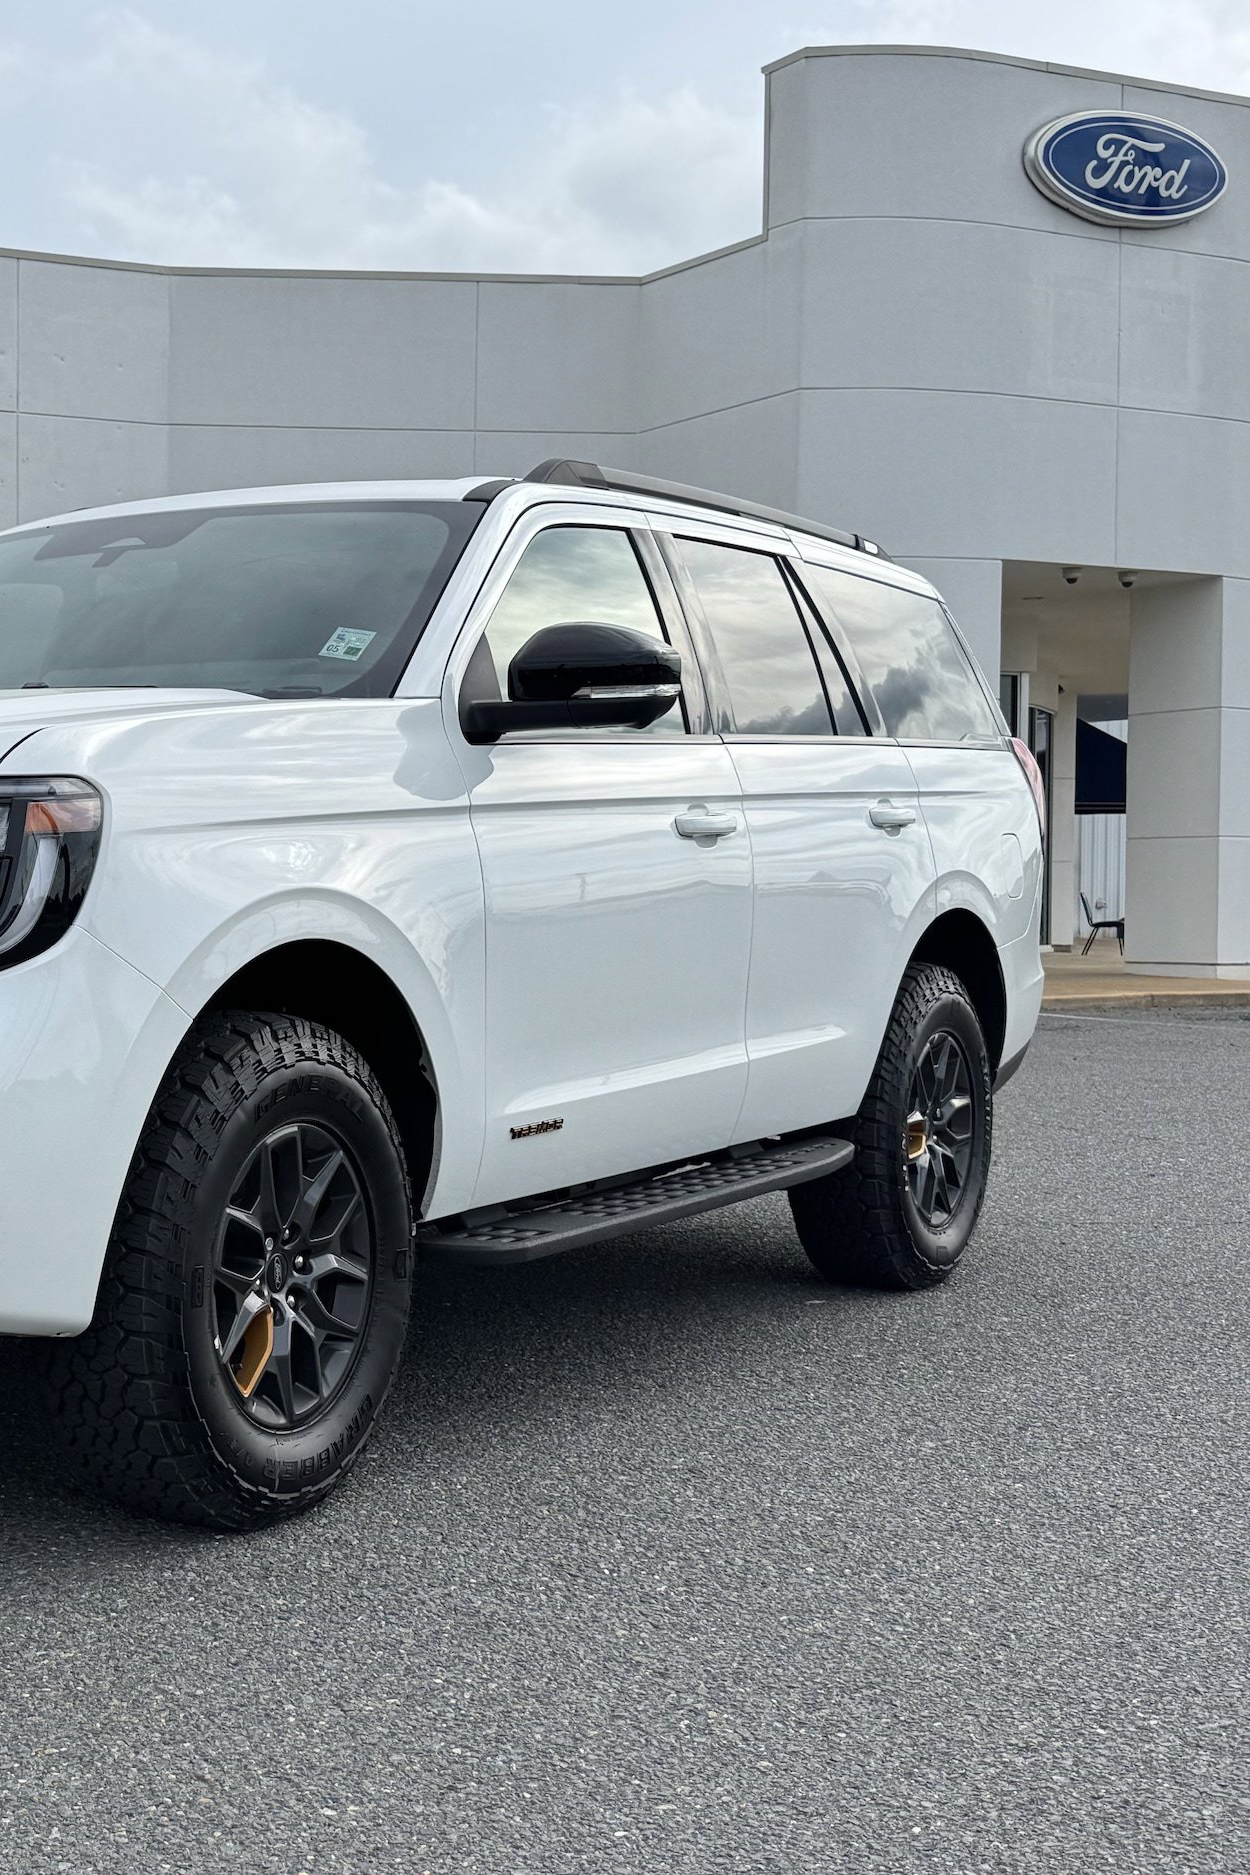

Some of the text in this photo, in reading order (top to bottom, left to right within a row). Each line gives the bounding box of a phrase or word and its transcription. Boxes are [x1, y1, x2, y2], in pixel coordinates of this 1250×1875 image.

[1084, 132, 1191, 200] Ford
[326, 644, 341, 653] 05
[254, 1073, 366, 1124] GENERAL
